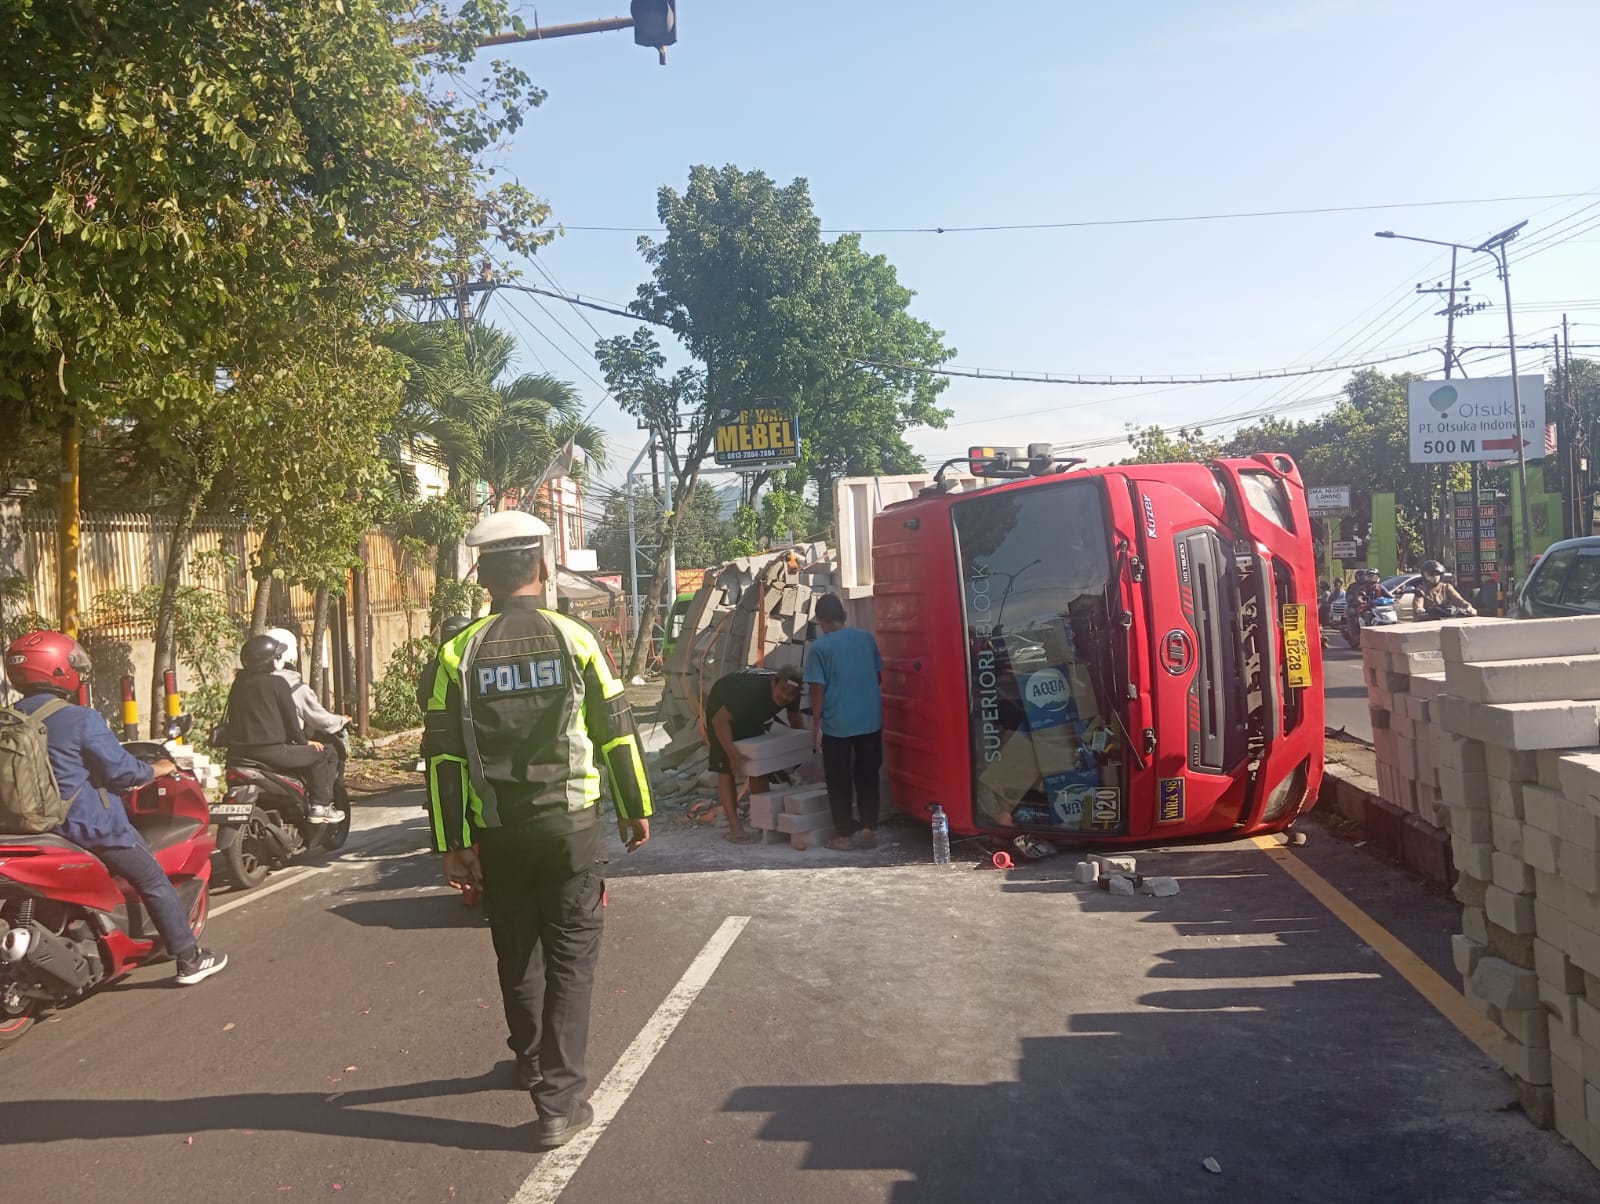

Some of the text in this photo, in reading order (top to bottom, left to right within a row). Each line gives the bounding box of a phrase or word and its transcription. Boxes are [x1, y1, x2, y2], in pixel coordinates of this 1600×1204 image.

[717, 421, 794, 452] MEBEL
[1419, 424, 1434, 433] PT.
[1437, 422, 1477, 433] Otsuka
[1423, 440, 1475, 454] 500 M
[971, 564, 993, 637] BLOCK
[1287, 639, 1302, 671] 8220
[478, 659, 563, 696] POLISI
[1032, 679, 1066, 697] AQUA
[1095, 790, 1117, 820] 020
[1163, 780, 1179, 818] WIRA 98
